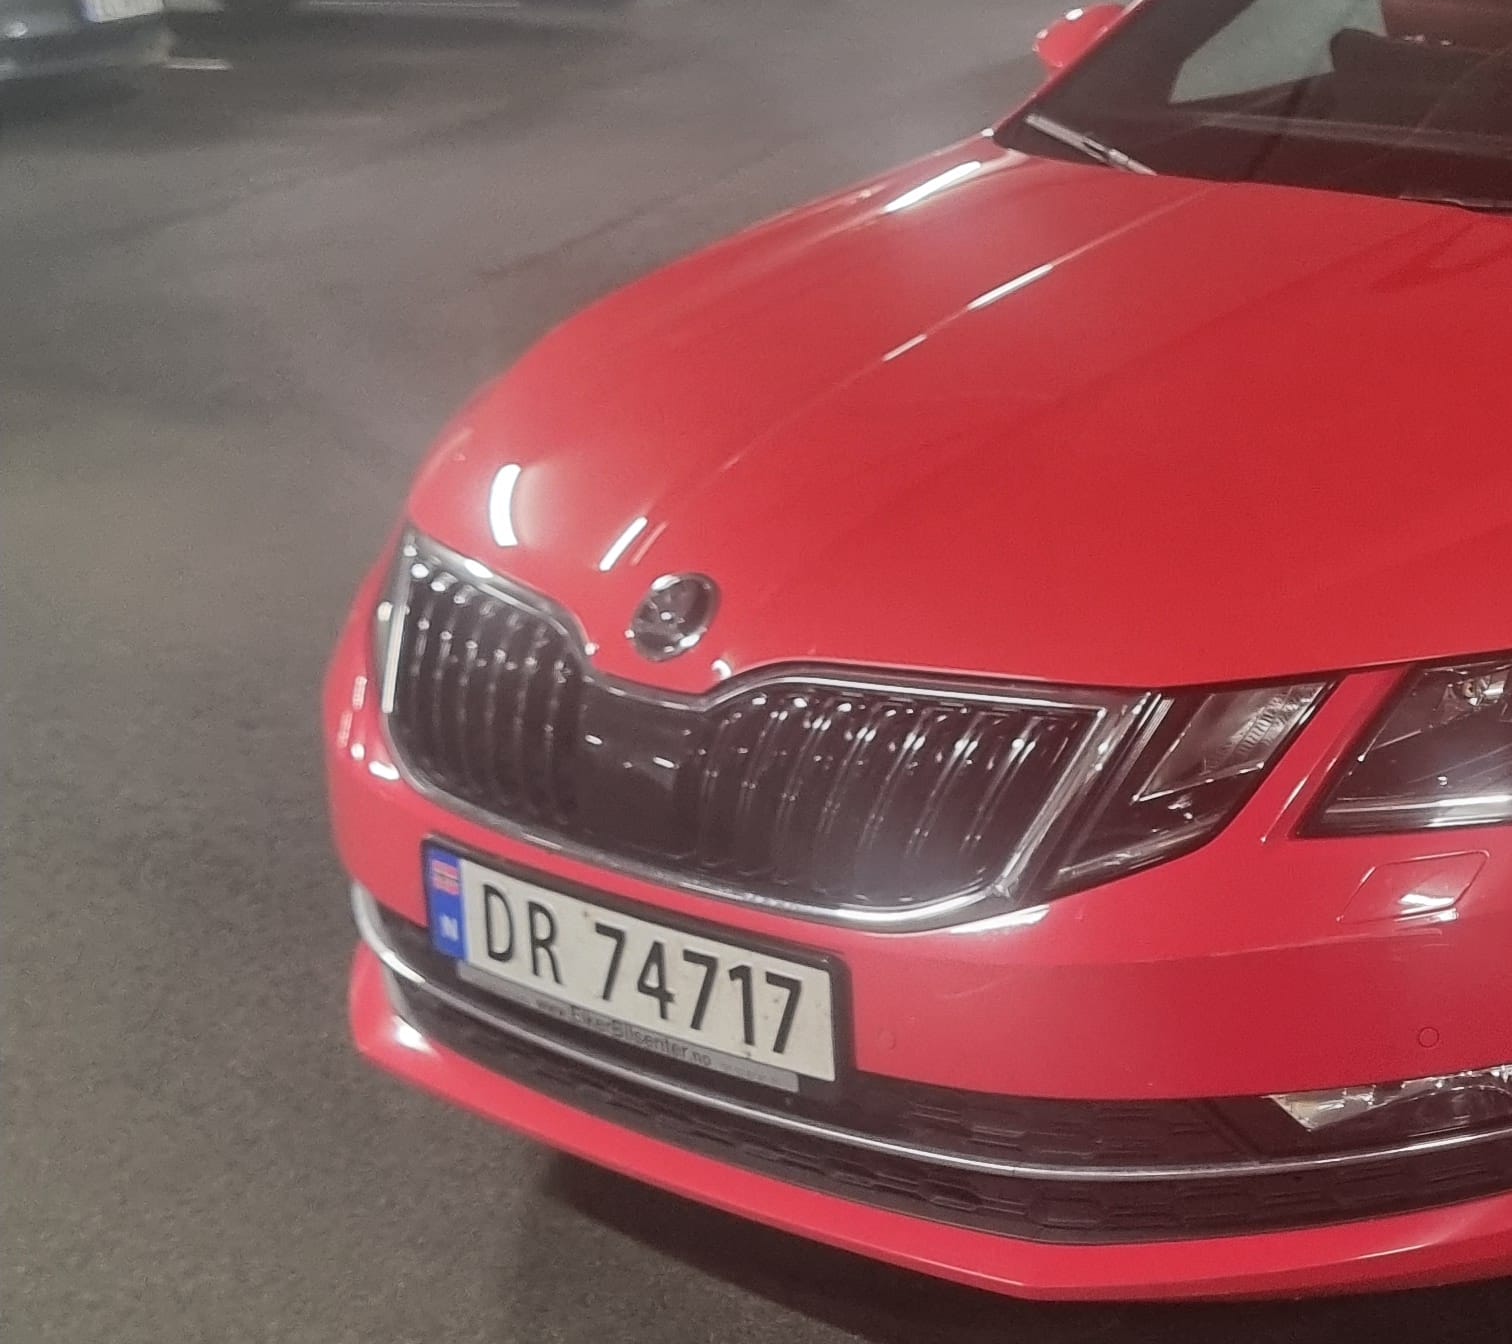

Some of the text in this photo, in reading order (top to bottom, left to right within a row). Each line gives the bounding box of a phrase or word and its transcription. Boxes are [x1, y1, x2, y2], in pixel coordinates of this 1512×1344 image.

[440, 913, 459, 942] N
[483, 883, 802, 1054] DR 74717
